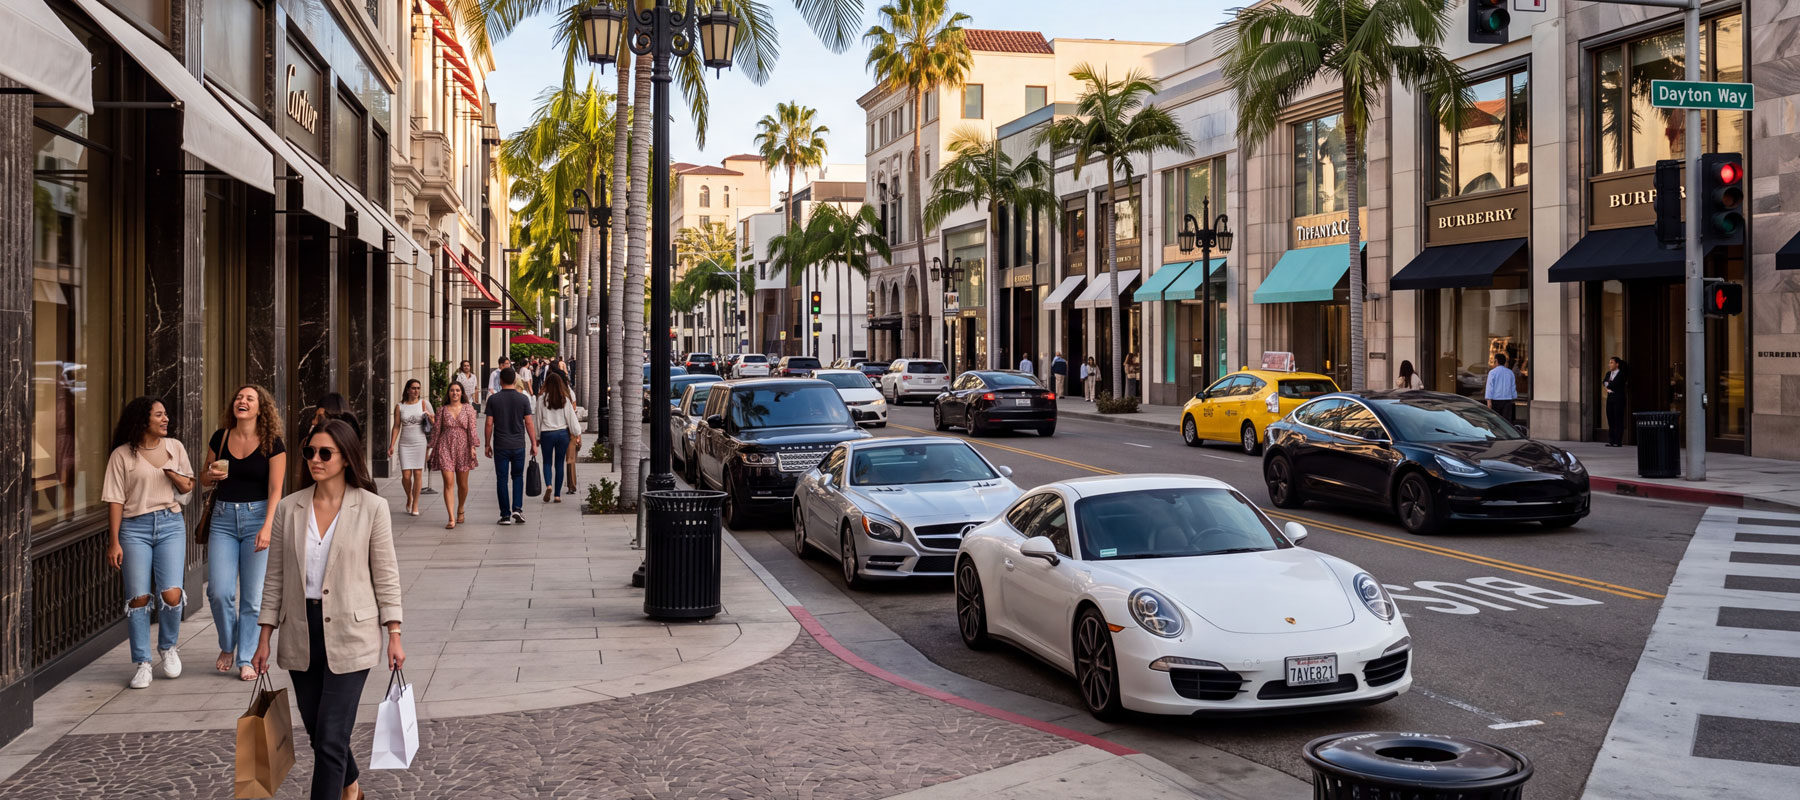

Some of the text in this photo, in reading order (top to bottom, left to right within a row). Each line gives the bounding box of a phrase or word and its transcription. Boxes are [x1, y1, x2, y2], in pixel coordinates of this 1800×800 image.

[286, 64, 318, 134] Cartier
[1659, 86, 1747, 108] Dayton Way
[1438, 208, 1515, 229] BURBERRY
[1382, 576, 1604, 615] BUS
[1290, 665, 1335, 682] 7AYE821
